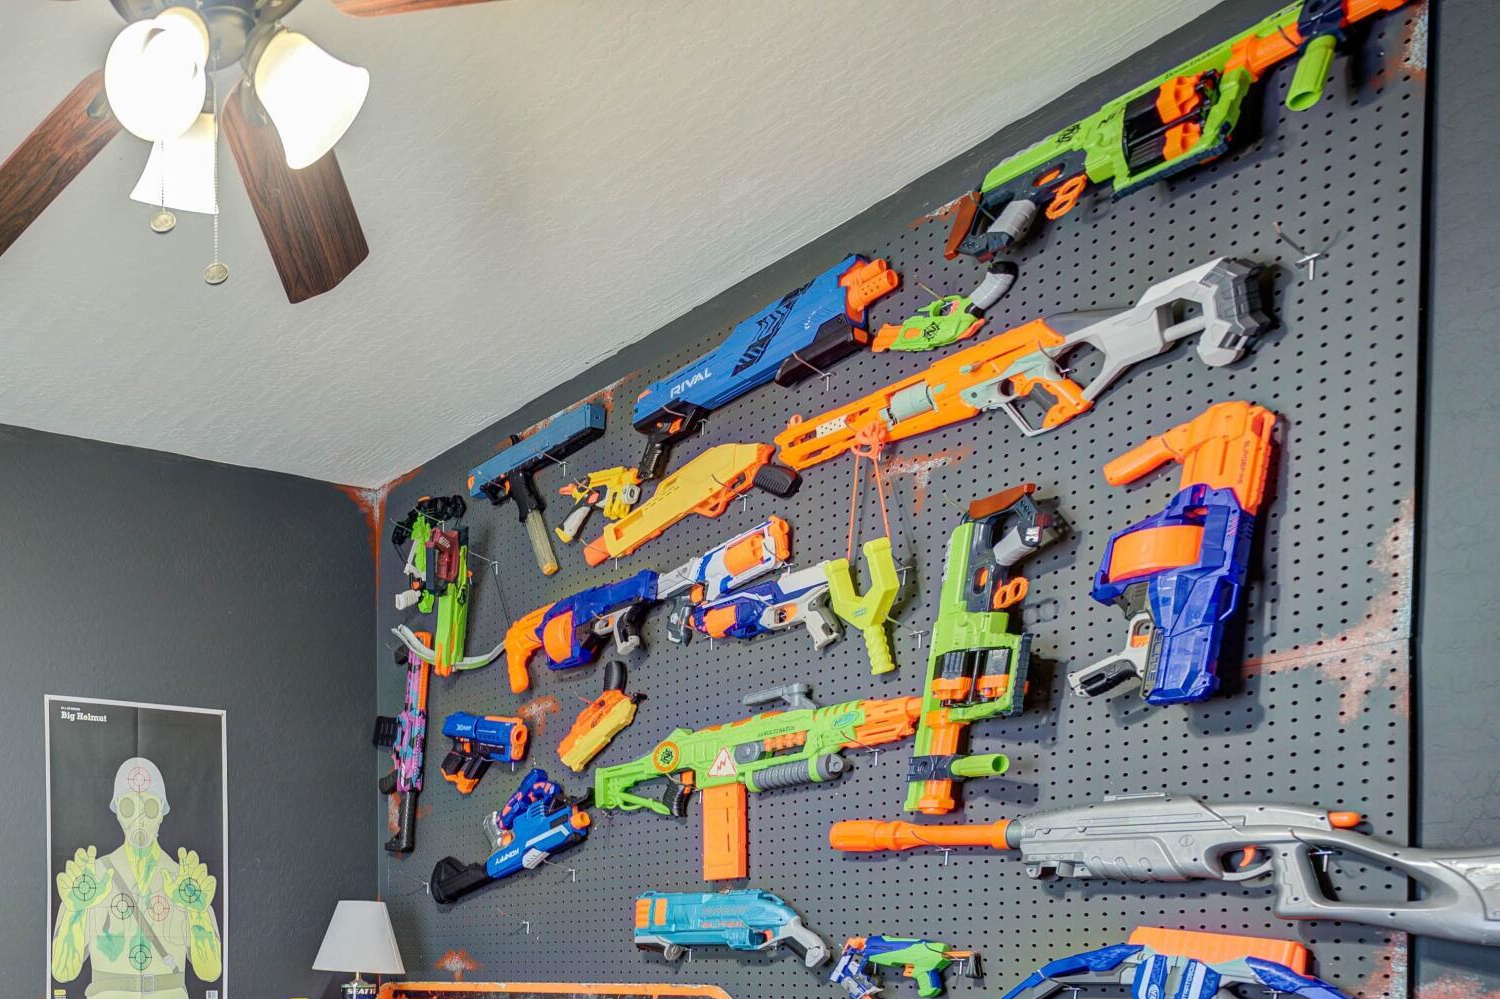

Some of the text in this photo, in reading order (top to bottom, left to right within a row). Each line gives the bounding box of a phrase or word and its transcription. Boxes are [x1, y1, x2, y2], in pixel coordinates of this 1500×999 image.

[669, 367, 712, 399] RIVAL
[60, 710, 108, 723] Big Helmut
